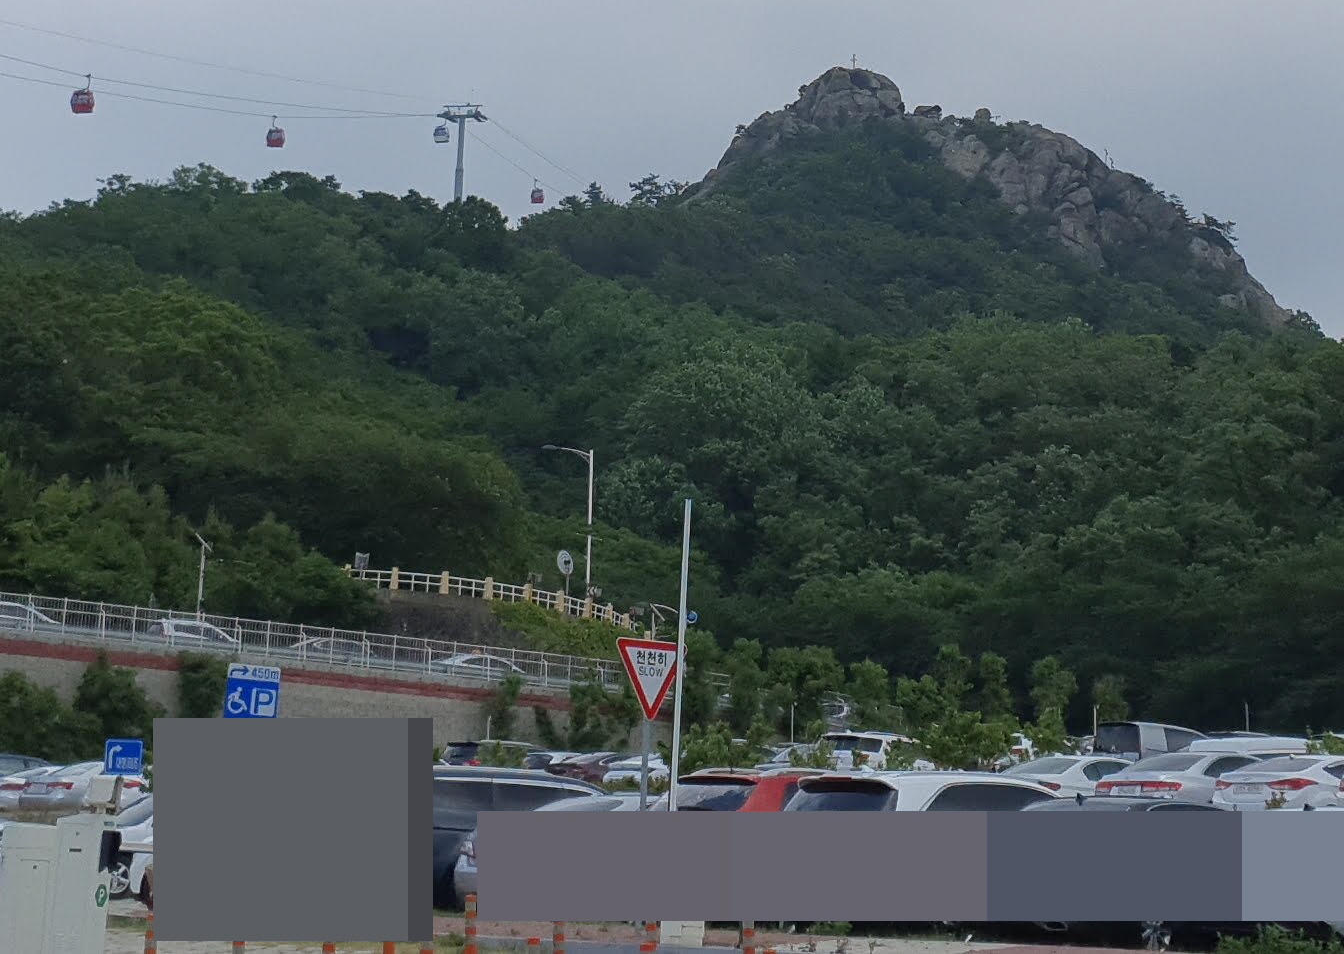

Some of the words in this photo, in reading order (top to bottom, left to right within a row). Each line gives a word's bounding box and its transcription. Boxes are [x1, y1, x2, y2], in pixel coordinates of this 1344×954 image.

[637, 650, 667, 667] 천천히
[252, 667, 279, 679] 450m
[638, 666, 664, 677] SLOW
